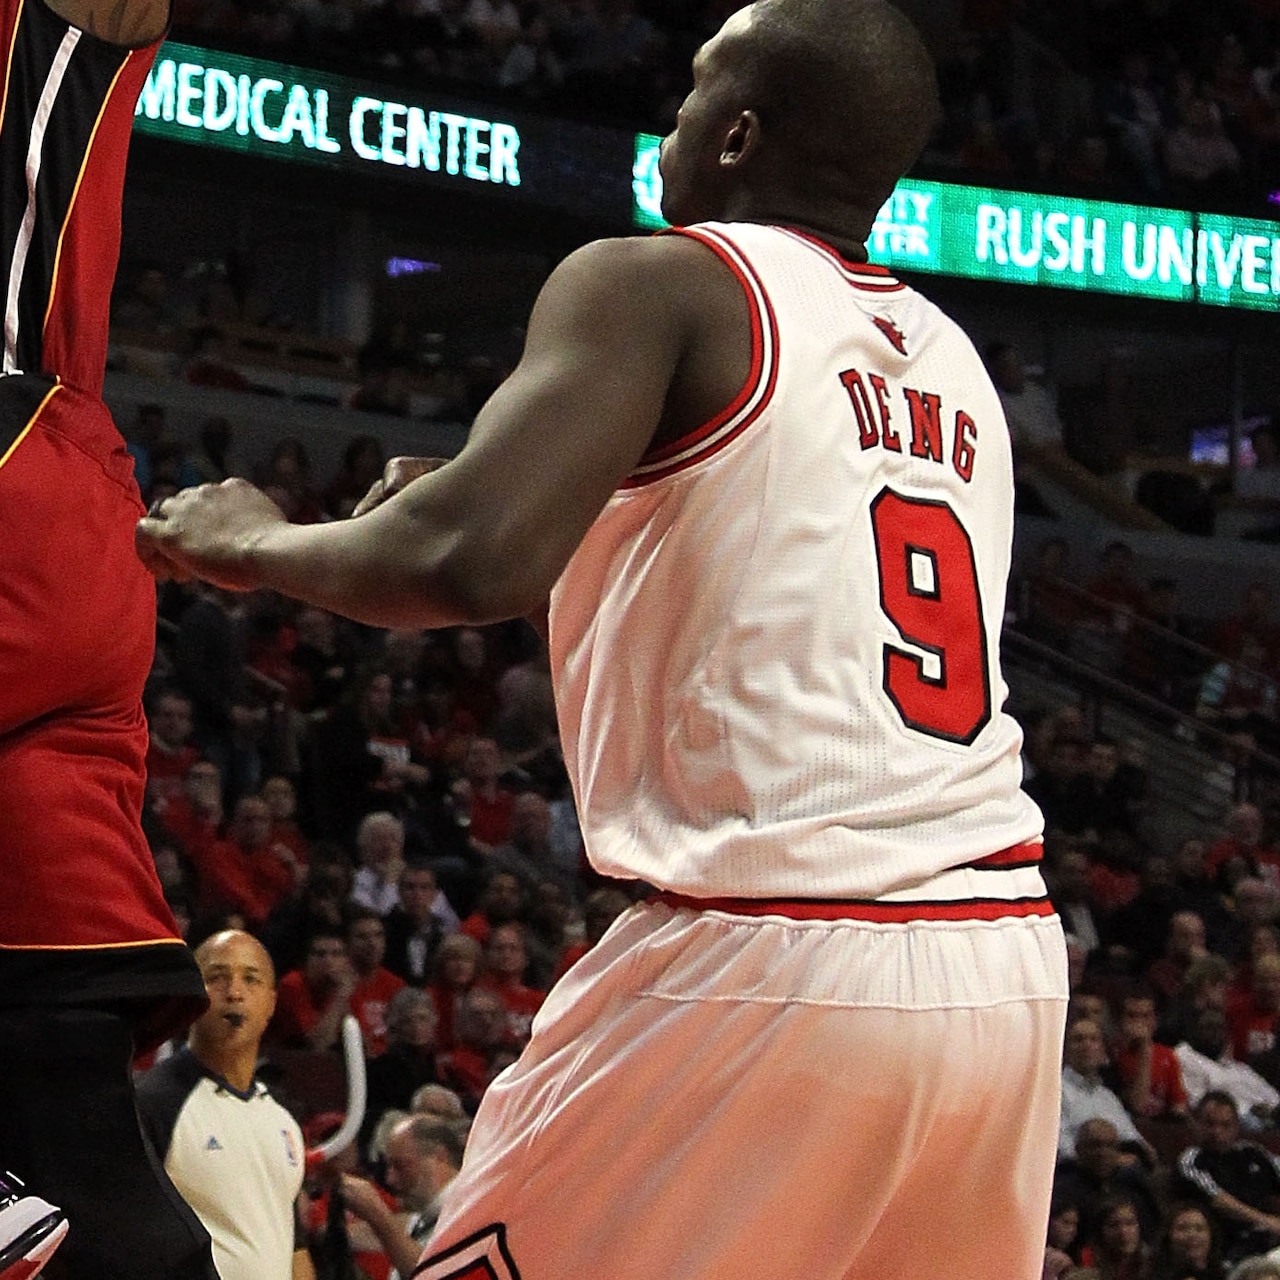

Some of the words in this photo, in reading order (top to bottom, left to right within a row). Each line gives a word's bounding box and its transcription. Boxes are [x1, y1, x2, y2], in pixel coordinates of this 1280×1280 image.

[135, 59, 341, 154] MEDICAL
[349, 96, 521, 186] CENTER
[976, 203, 1107, 275] RUSH
[839, 368, 978, 483] DENG
[869, 484, 992, 747] 9
